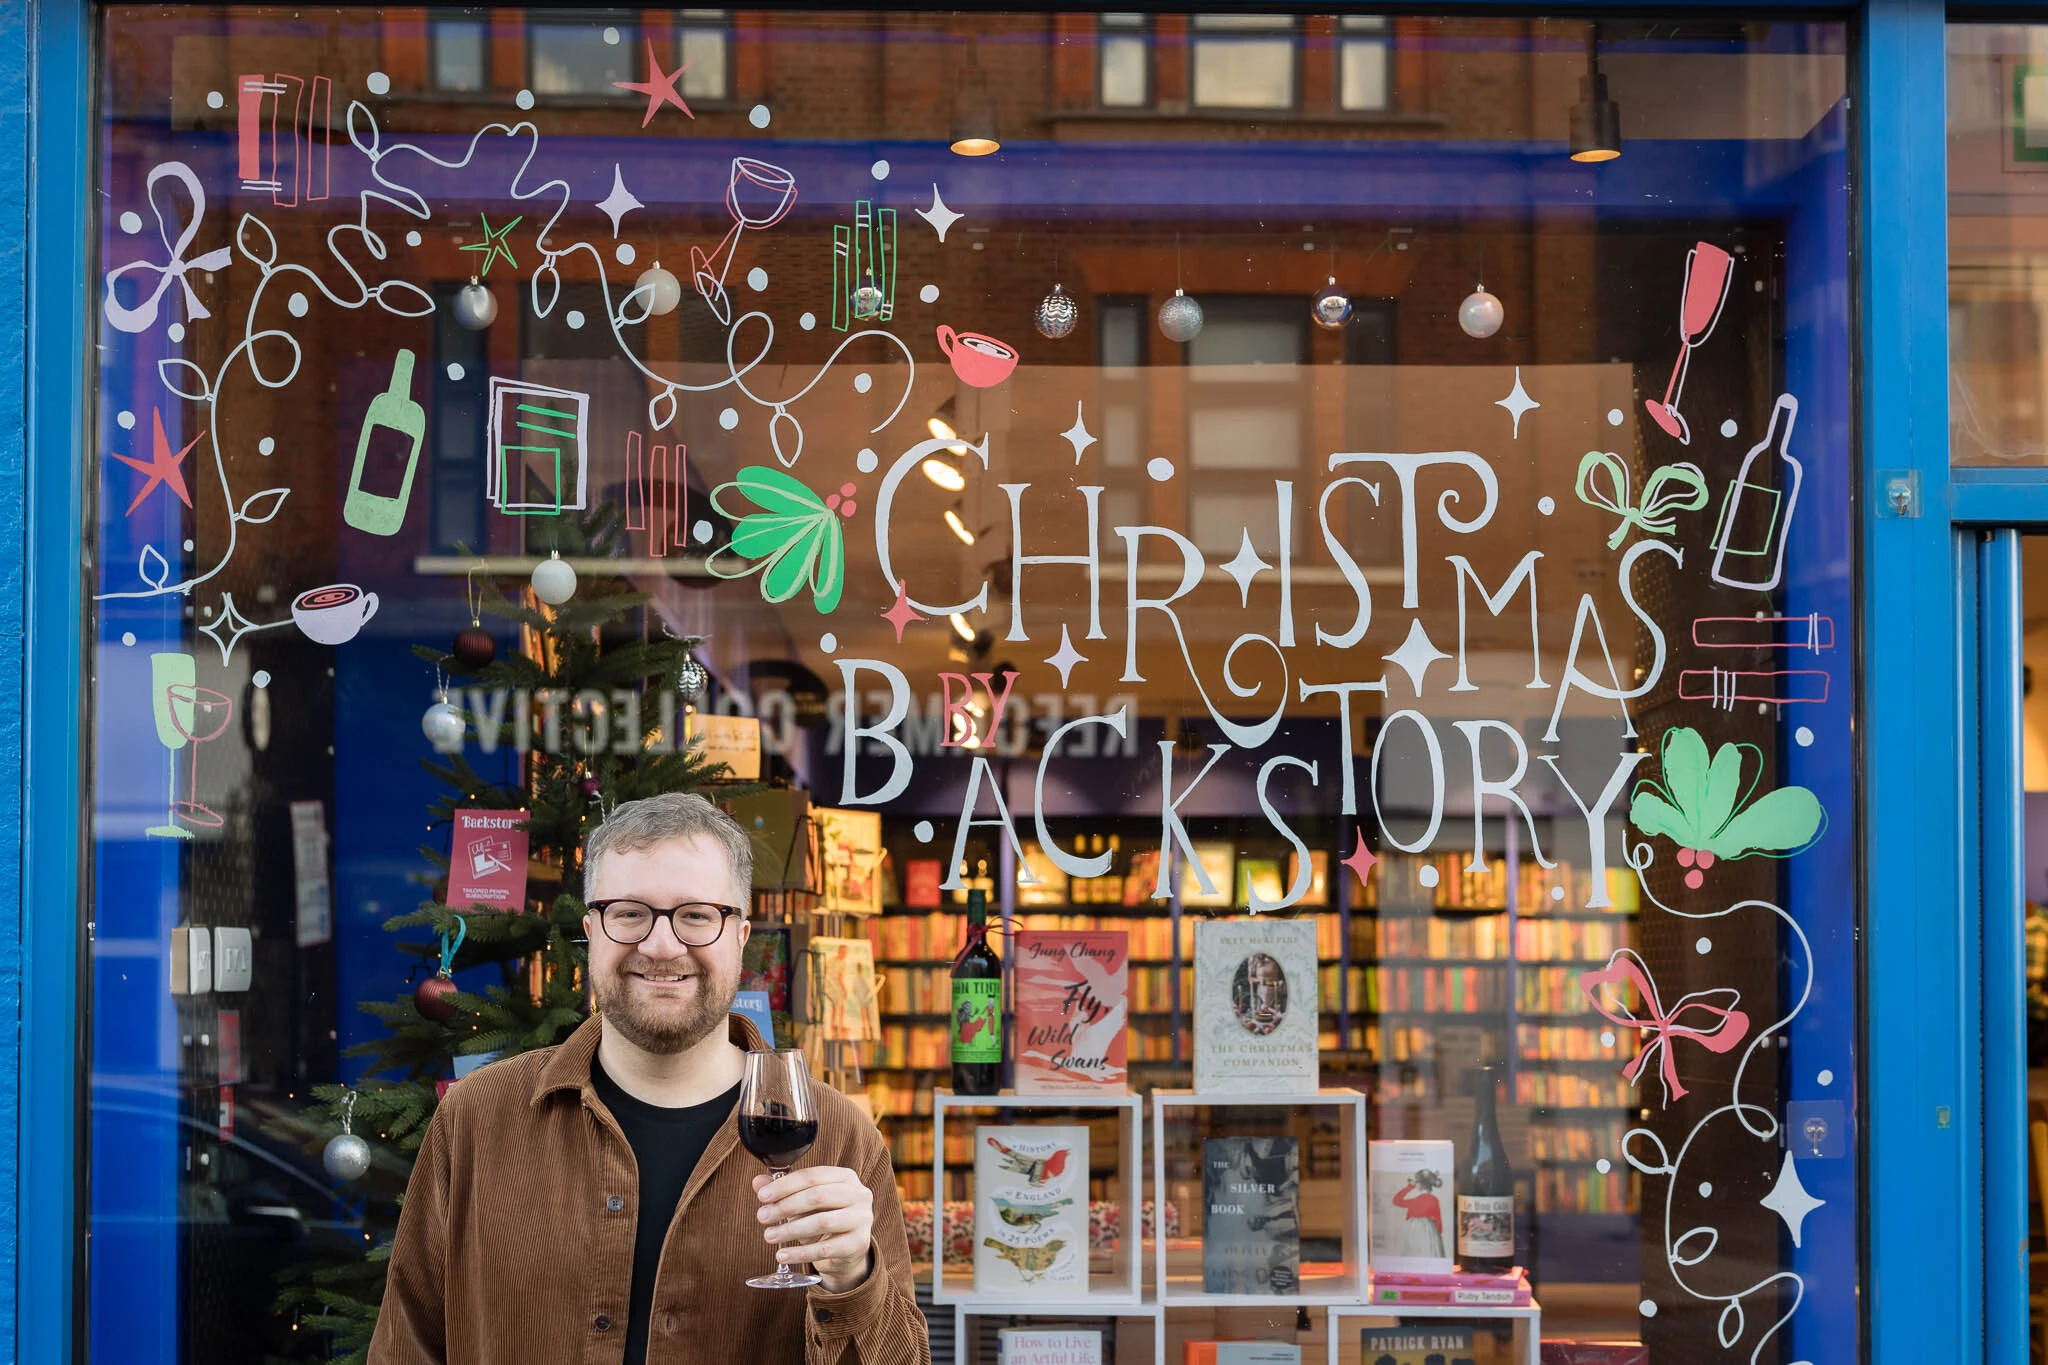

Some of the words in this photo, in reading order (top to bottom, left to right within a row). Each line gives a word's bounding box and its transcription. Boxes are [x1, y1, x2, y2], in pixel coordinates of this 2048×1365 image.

[875, 432, 1684, 747] CHRISTMAS
[938, 671, 1020, 747] BY
[833, 658, 1653, 915] BACKSTORY
[1029, 942, 1067, 962] Jung
[1069, 942, 1116, 963] Chang
[1063, 980, 1109, 1024] Fly,
[1027, 1023, 1079, 1046] Wild
[1050, 1049, 1109, 1072] Swans
[1212, 1161, 1229, 1169] THE
[1016, 1187, 1061, 1201] ENGLAND
[1230, 1183, 1276, 1194] SILVER
[1211, 1204, 1245, 1215] BOOK
[1014, 1336, 1043, 1349] How
[1047, 1337, 1061, 1349] to
[1065, 1335, 1092, 1349] Live
[1370, 1336, 1425, 1351] PATRICK
[1431, 1335, 1464, 1350] RYAN
